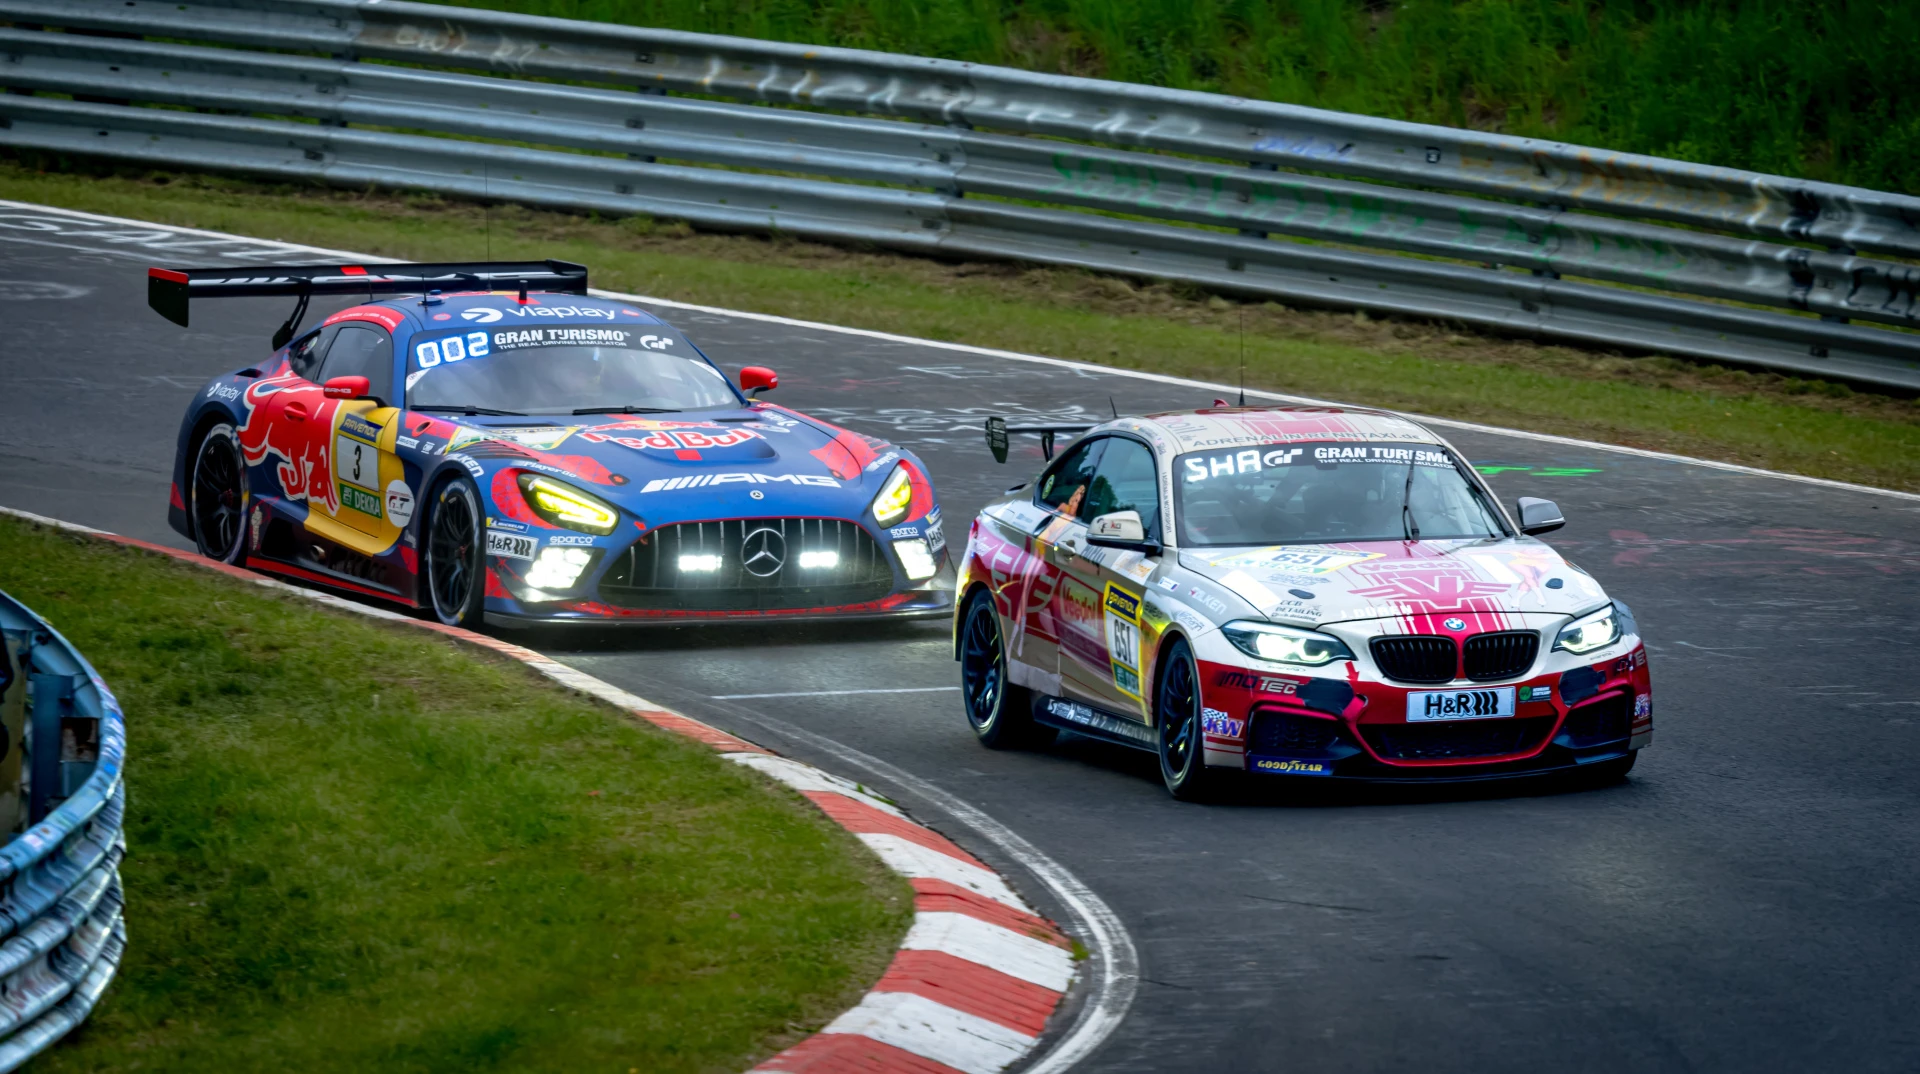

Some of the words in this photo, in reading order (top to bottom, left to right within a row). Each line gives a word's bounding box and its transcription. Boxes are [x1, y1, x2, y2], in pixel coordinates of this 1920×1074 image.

[506, 305, 616, 321] viaplay
[494, 329, 543, 346] GRAN
[547, 328, 624, 341] TURISMO
[542, 339, 577, 347] DRIVING
[578, 339, 628, 348] SIMULATOR
[416, 331, 490, 369] 002
[343, 418, 378, 438] RAVENOL
[670, 428, 767, 449] Bull
[1314, 447, 1367, 459] GRAN
[353, 445, 362, 481] 3
[1184, 449, 1262, 483] SHA
[1405, 460, 1457, 470] SMULATOR
[708, 473, 842, 489] AMG
[354, 493, 382, 517] DEKRA
[550, 535, 594, 544] sparco
[890, 526, 919, 537] sparco
[487, 534, 513, 552] H&R
[1270, 553, 1333, 566] 651
[1360, 560, 1465, 572] Veedol
[1275, 606, 1323, 617] DETAILING
[1114, 619, 1133, 665] 651
[1424, 693, 1473, 718] H&R
[1205, 717, 1245, 738] KW
[1256, 760, 1324, 773] GOODYEAR
